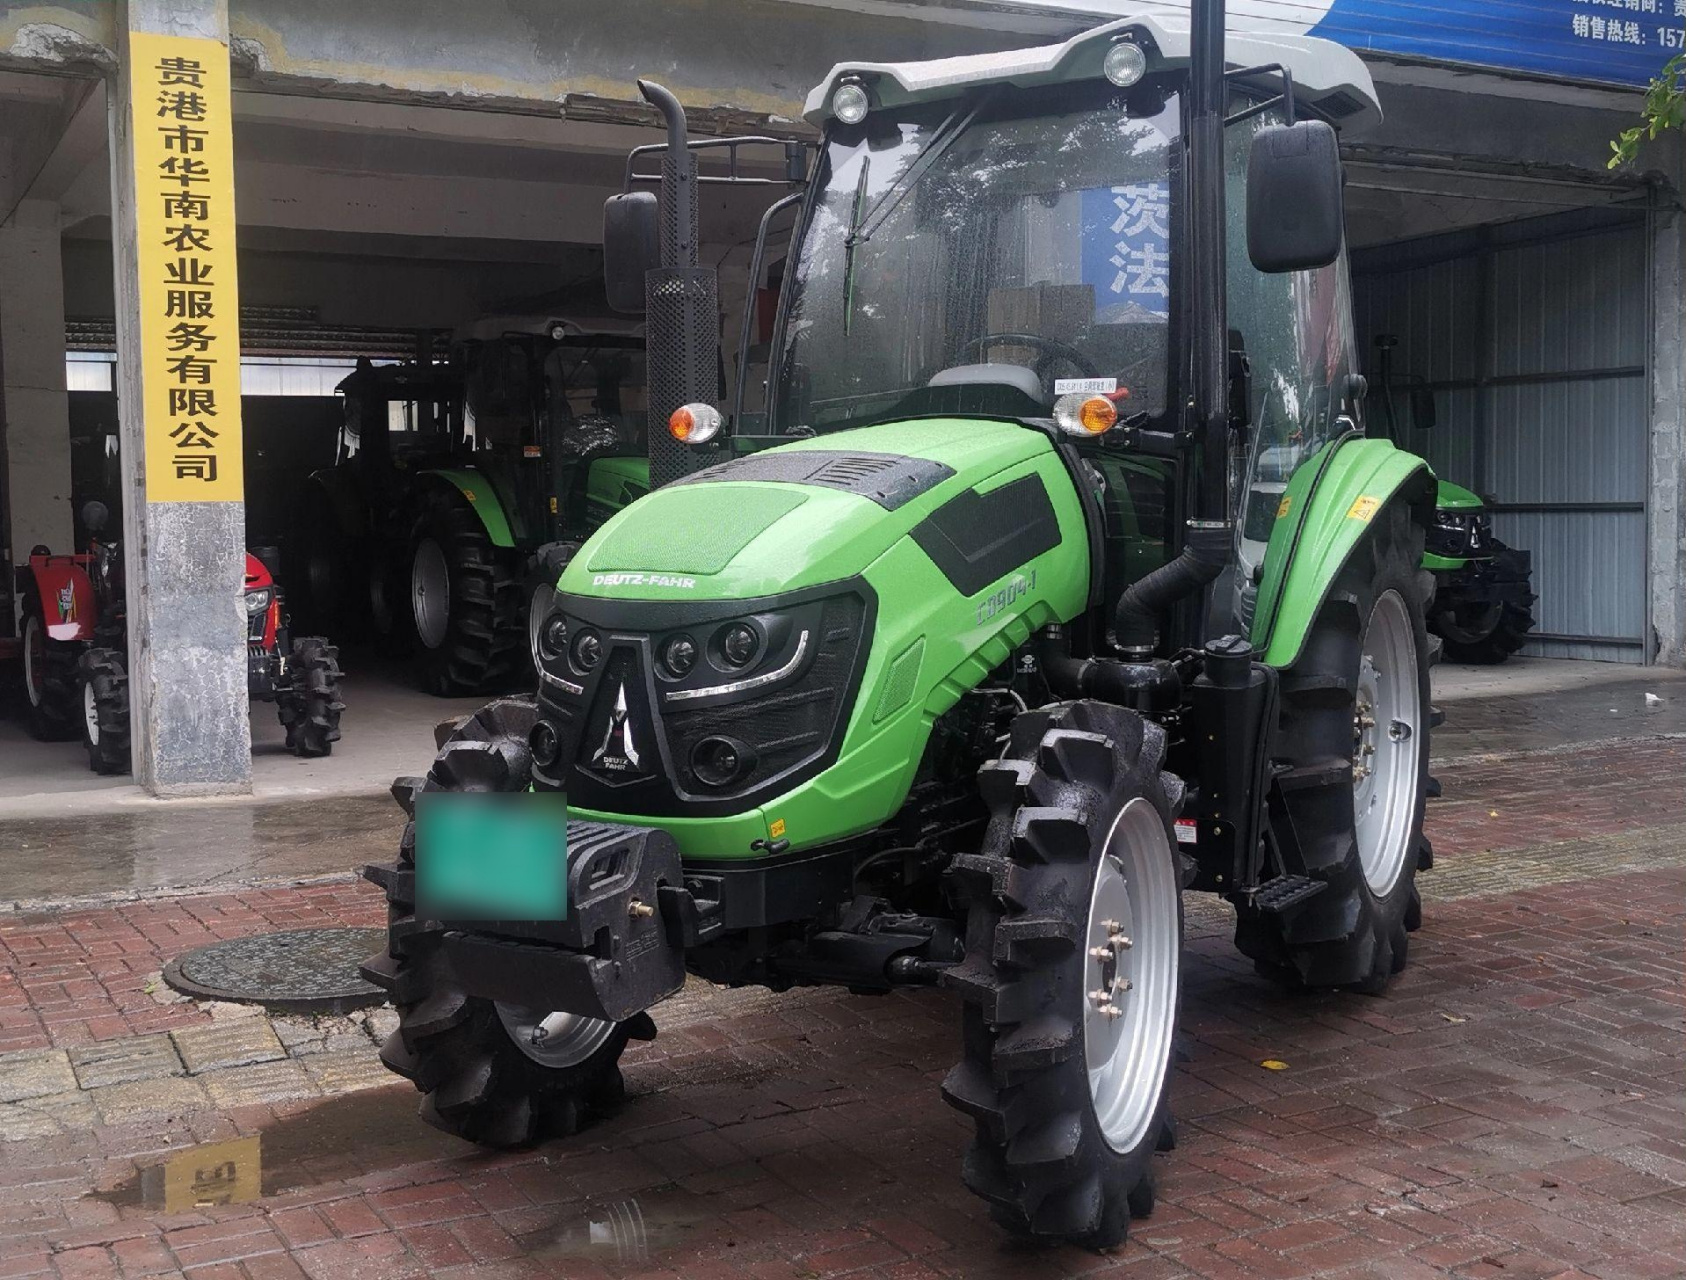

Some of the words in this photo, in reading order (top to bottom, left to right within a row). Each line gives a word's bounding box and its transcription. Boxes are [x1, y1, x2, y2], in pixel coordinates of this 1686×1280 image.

[155, 56, 218, 483] 贵港市华南农业服务有限公司
[592, 574, 696, 589] DEUTZ-FAHR
